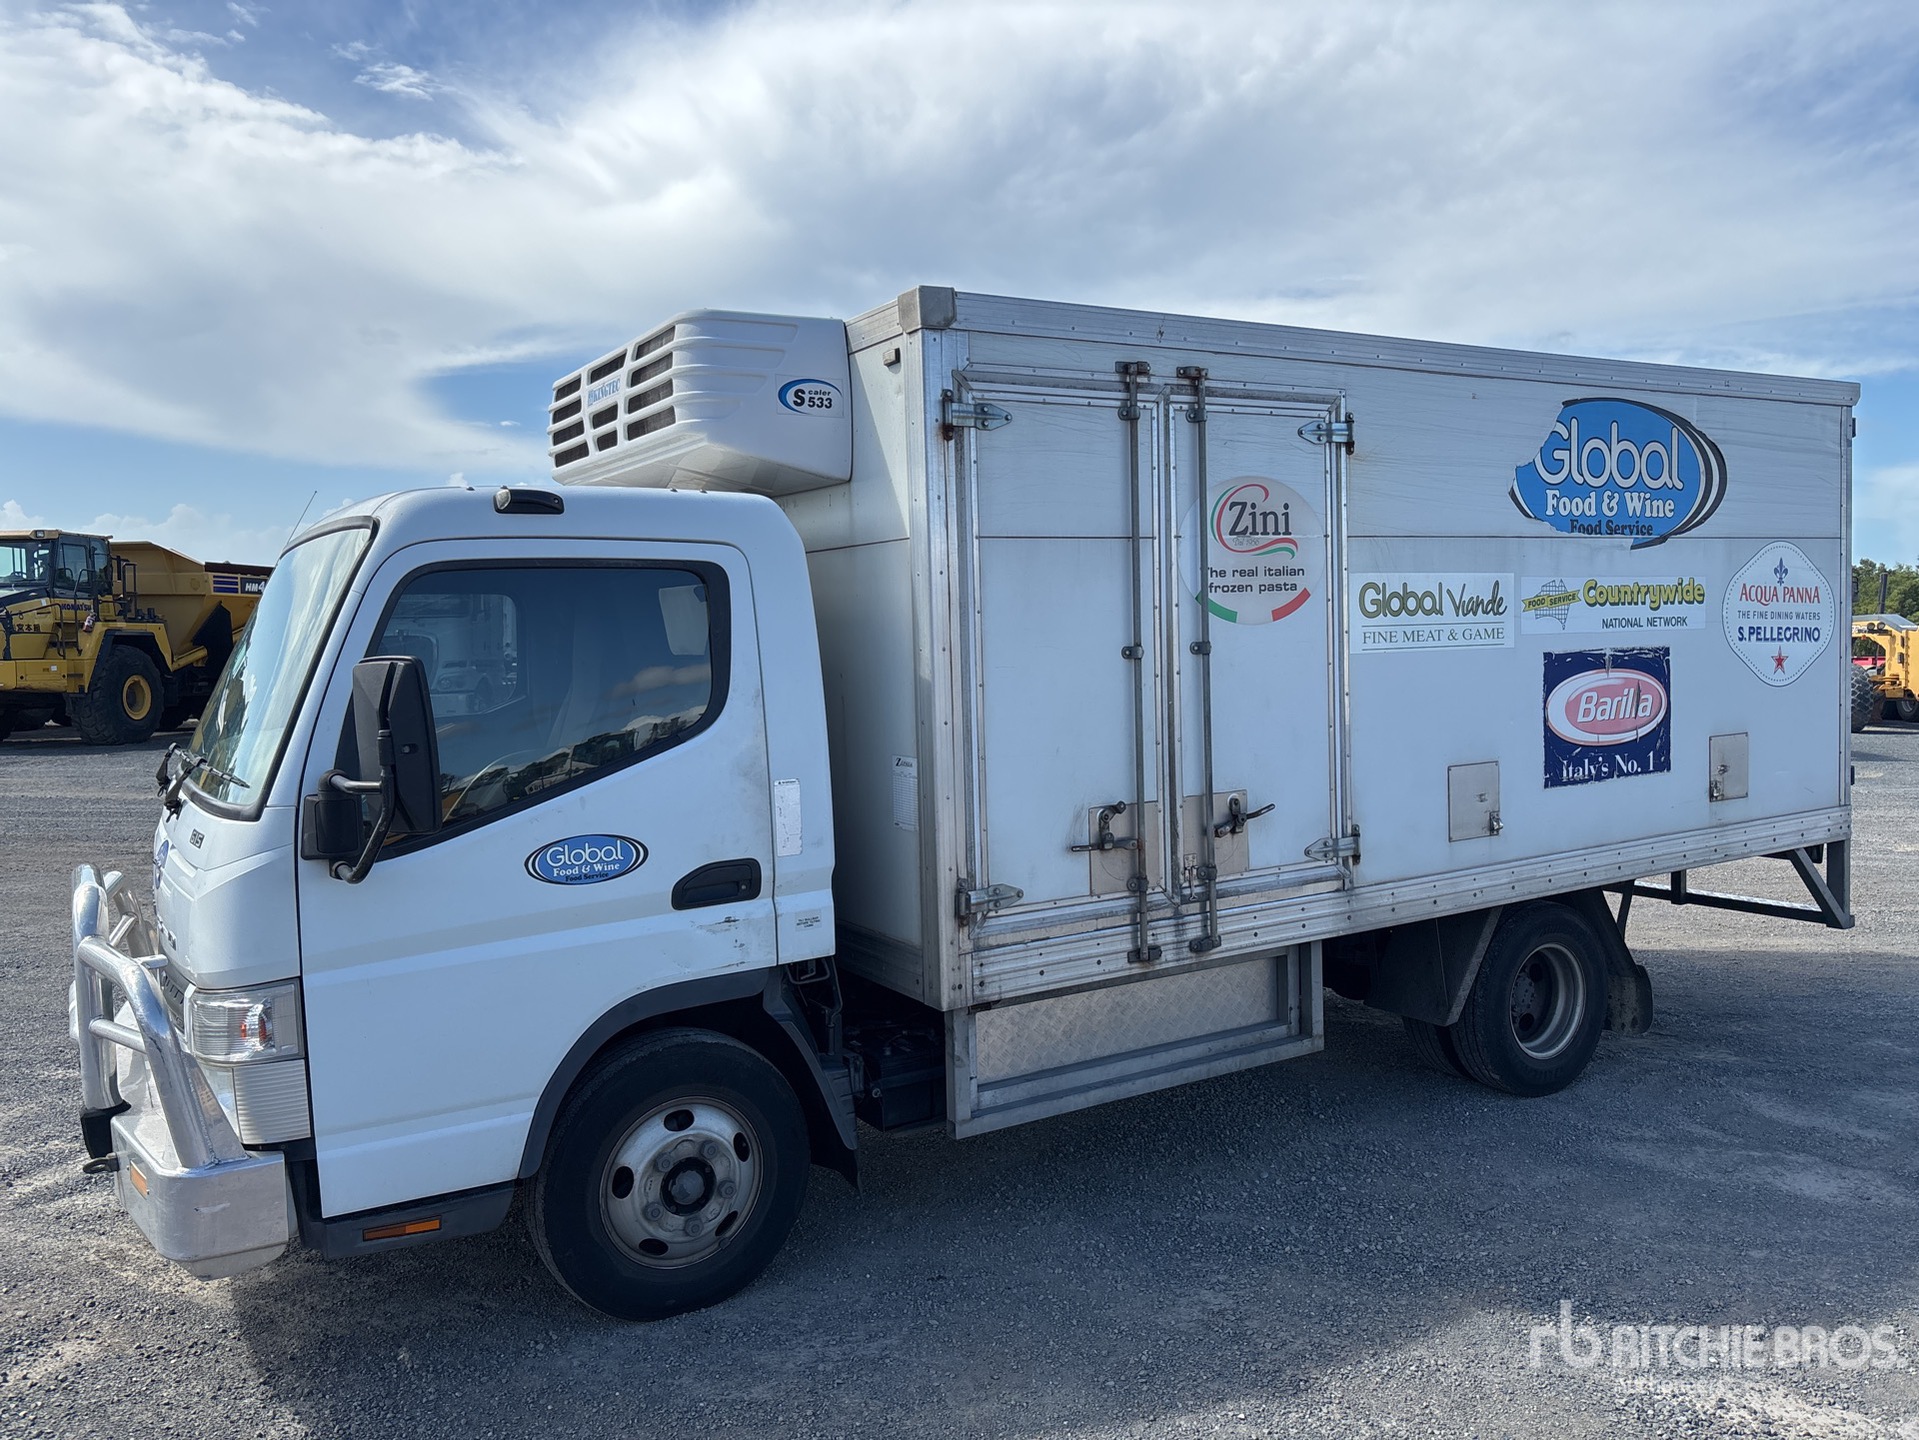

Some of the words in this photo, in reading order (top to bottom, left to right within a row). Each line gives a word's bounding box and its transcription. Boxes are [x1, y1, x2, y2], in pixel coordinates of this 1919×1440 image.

[808, 389, 831, 397] caler
[807, 397, 832, 409] 533
[1533, 416, 1684, 491] Global
[1545, 490, 1597, 516] Food
[1602, 490, 1618, 517] &
[1624, 491, 1675, 518] Wine
[1228, 501, 1292, 536] Zini
[1570, 519, 1602, 535] Food
[1604, 521, 1653, 536] Service
[1232, 566, 1258, 578] real
[1264, 566, 1305, 577] italian
[1208, 582, 1253, 593] frozen
[1258, 583, 1298, 594] pasta
[1583, 577, 1705, 611] Countrywide
[1739, 583, 1780, 606] ACQUA
[1782, 586, 1821, 604] PANNA
[1359, 582, 1444, 619] Global
[1446, 580, 1507, 617] Viande
[1528, 598, 1546, 609] FOOD
[1549, 593, 1577, 606] SERVICE
[1602, 618, 1643, 629] NATIONAL
[1647, 616, 1688, 628] NETWORK
[1738, 610, 1751, 620] THE
[1753, 611, 1769, 620] FINE
[1771, 611, 1793, 620] DINING
[1795, 612, 1821, 621] WATERS
[1363, 631, 1398, 644] FINE
[1402, 629, 1444, 643] MEAT
[1447, 629, 1459, 641] &
[1462, 628, 1505, 641] GAME
[1738, 626, 1821, 643] S.PELLEGRINO
[1561, 756, 1609, 782] Italy's
[1615, 754, 1642, 774] No.
[1647, 751, 1655, 771] 1
[546, 840, 624, 867] Global
[553, 867, 579, 877] Food
[581, 865, 591, 873] &
[593, 863, 620, 872] Wine
[565, 874, 582, 882] Food
[583, 872, 609, 880] Service
